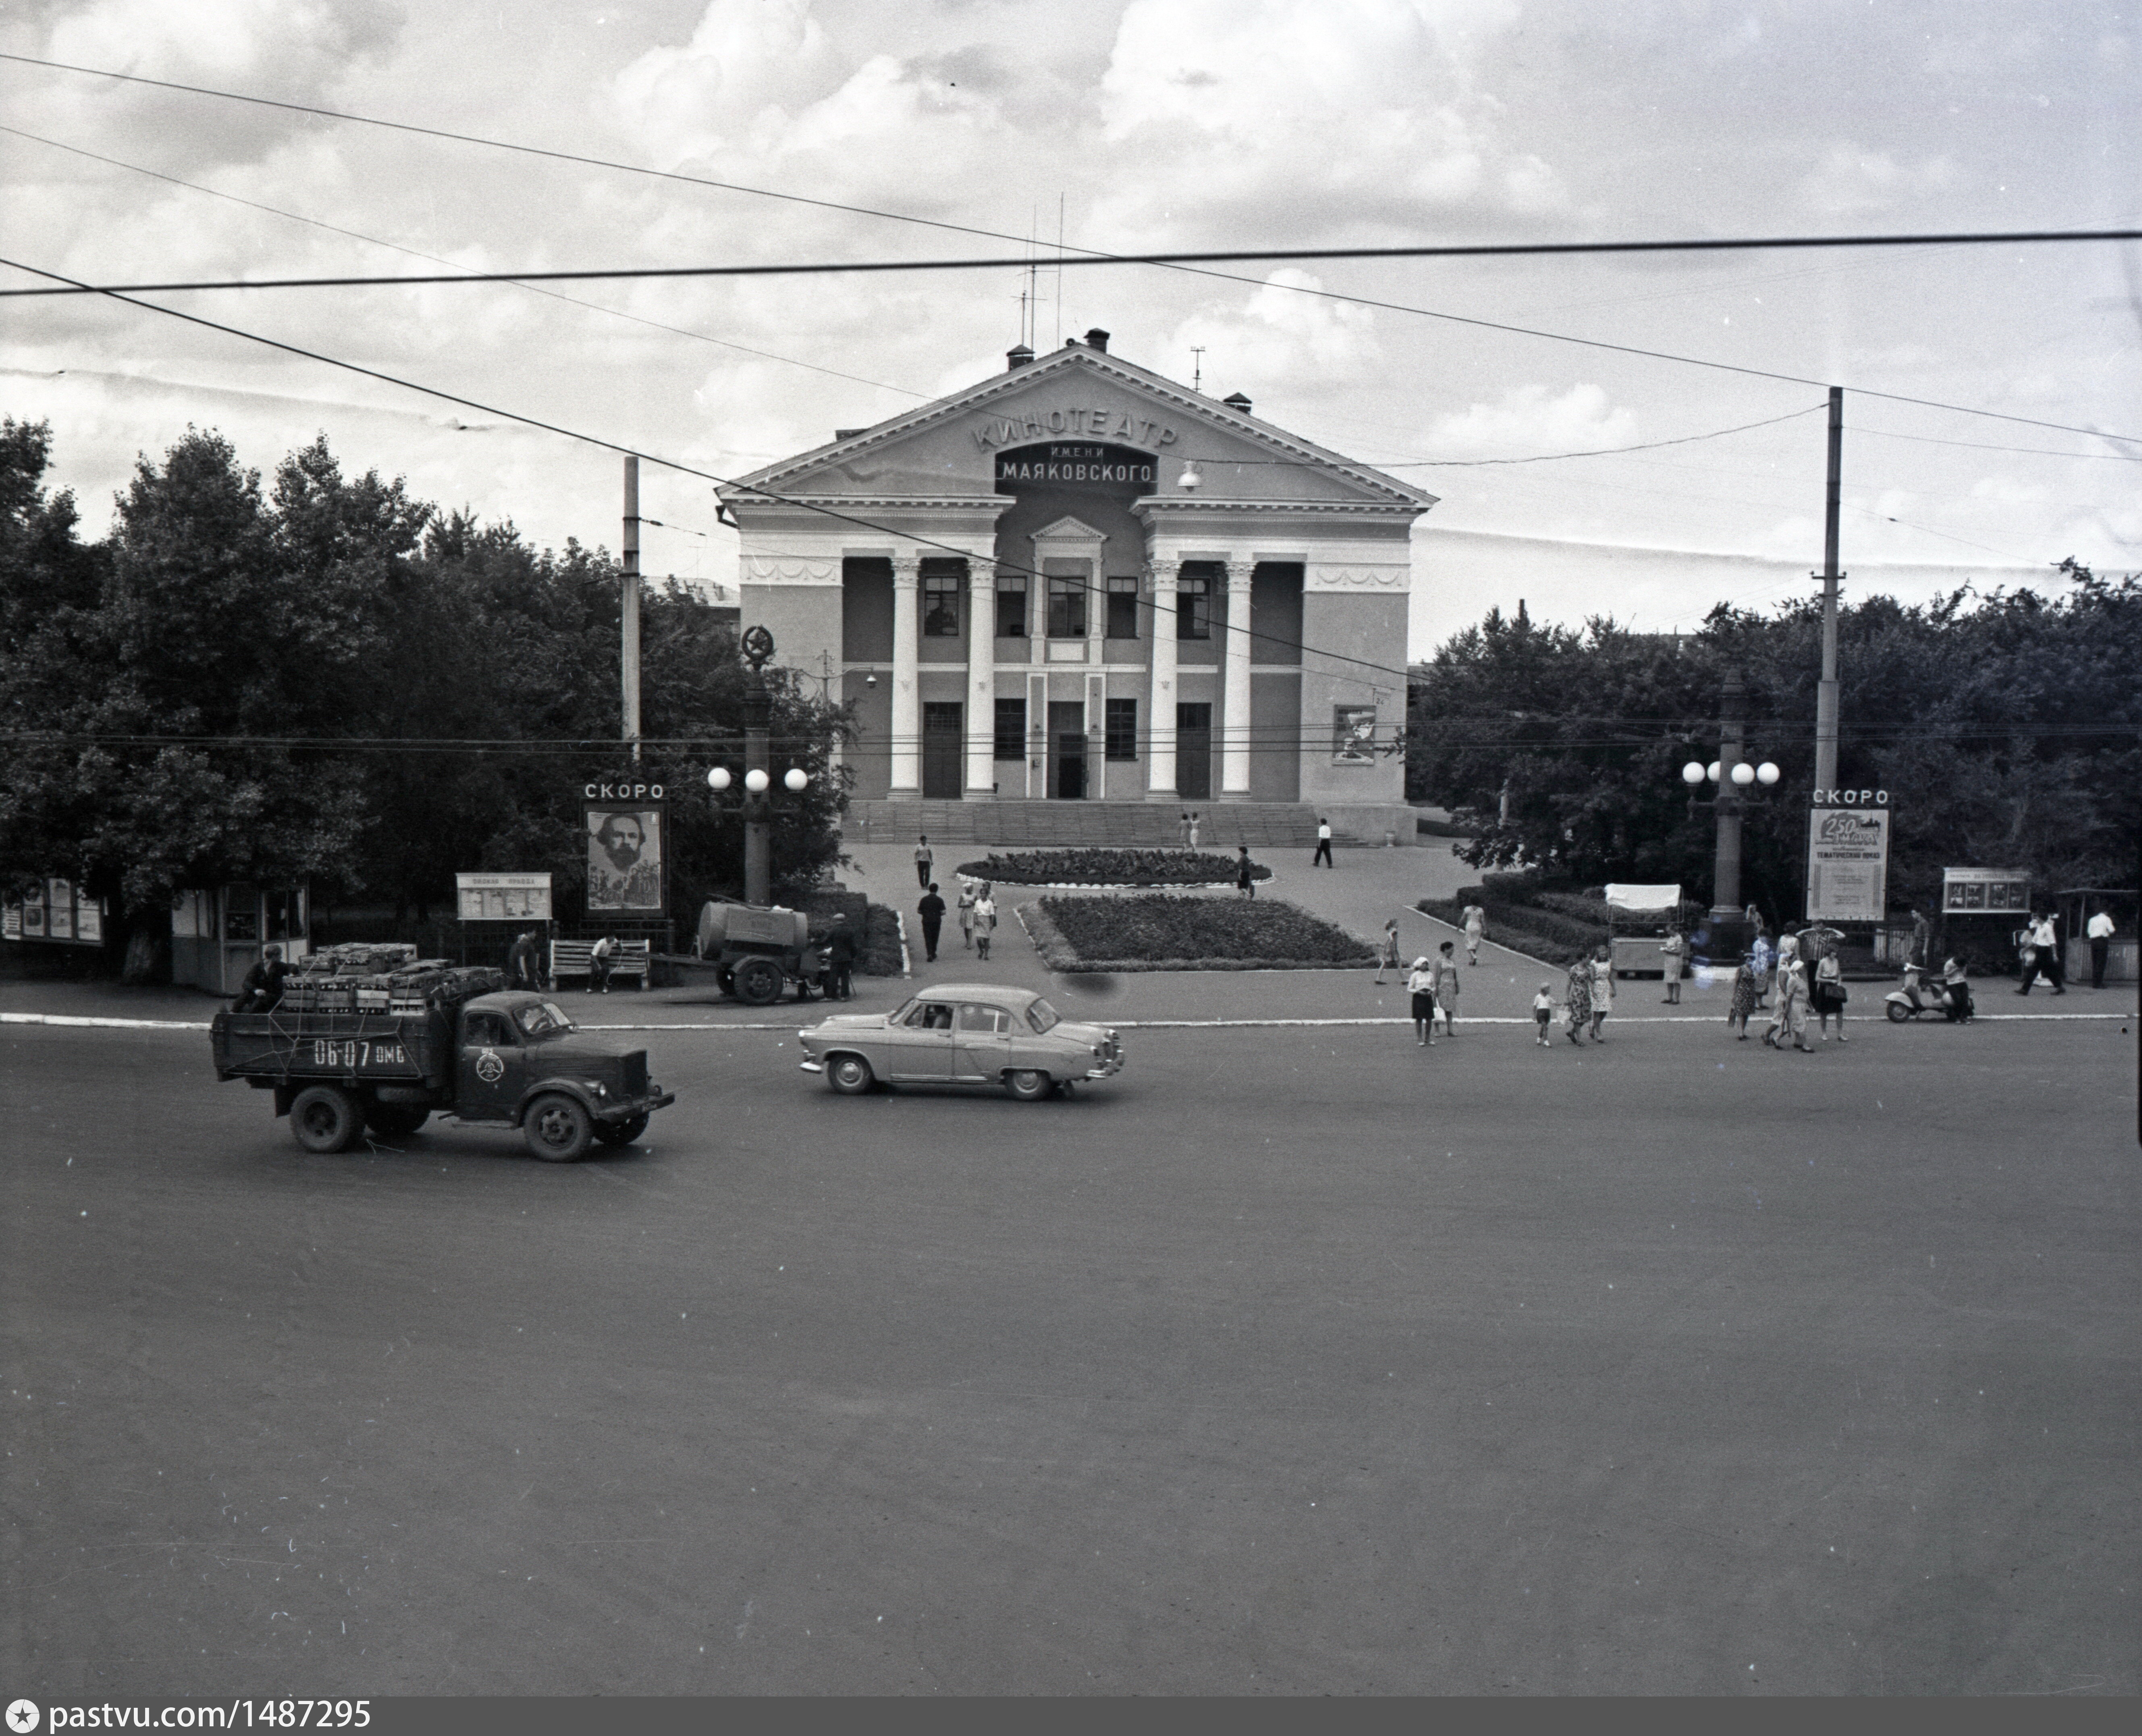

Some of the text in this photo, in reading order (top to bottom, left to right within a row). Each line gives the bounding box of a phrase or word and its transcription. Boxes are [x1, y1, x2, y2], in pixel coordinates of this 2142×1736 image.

[971, 407, 1179, 453] КИНОТЕАТР
[1051, 447, 1103, 456] ИМЕНИ
[1003, 462, 1151, 481] МАЯКОВСКОГО
[585, 784, 663, 798] СКОРО
[1813, 790, 1888, 804] СКОРО
[1825, 818, 1856, 835] 250
[315, 1040, 370, 1067] 06-07
